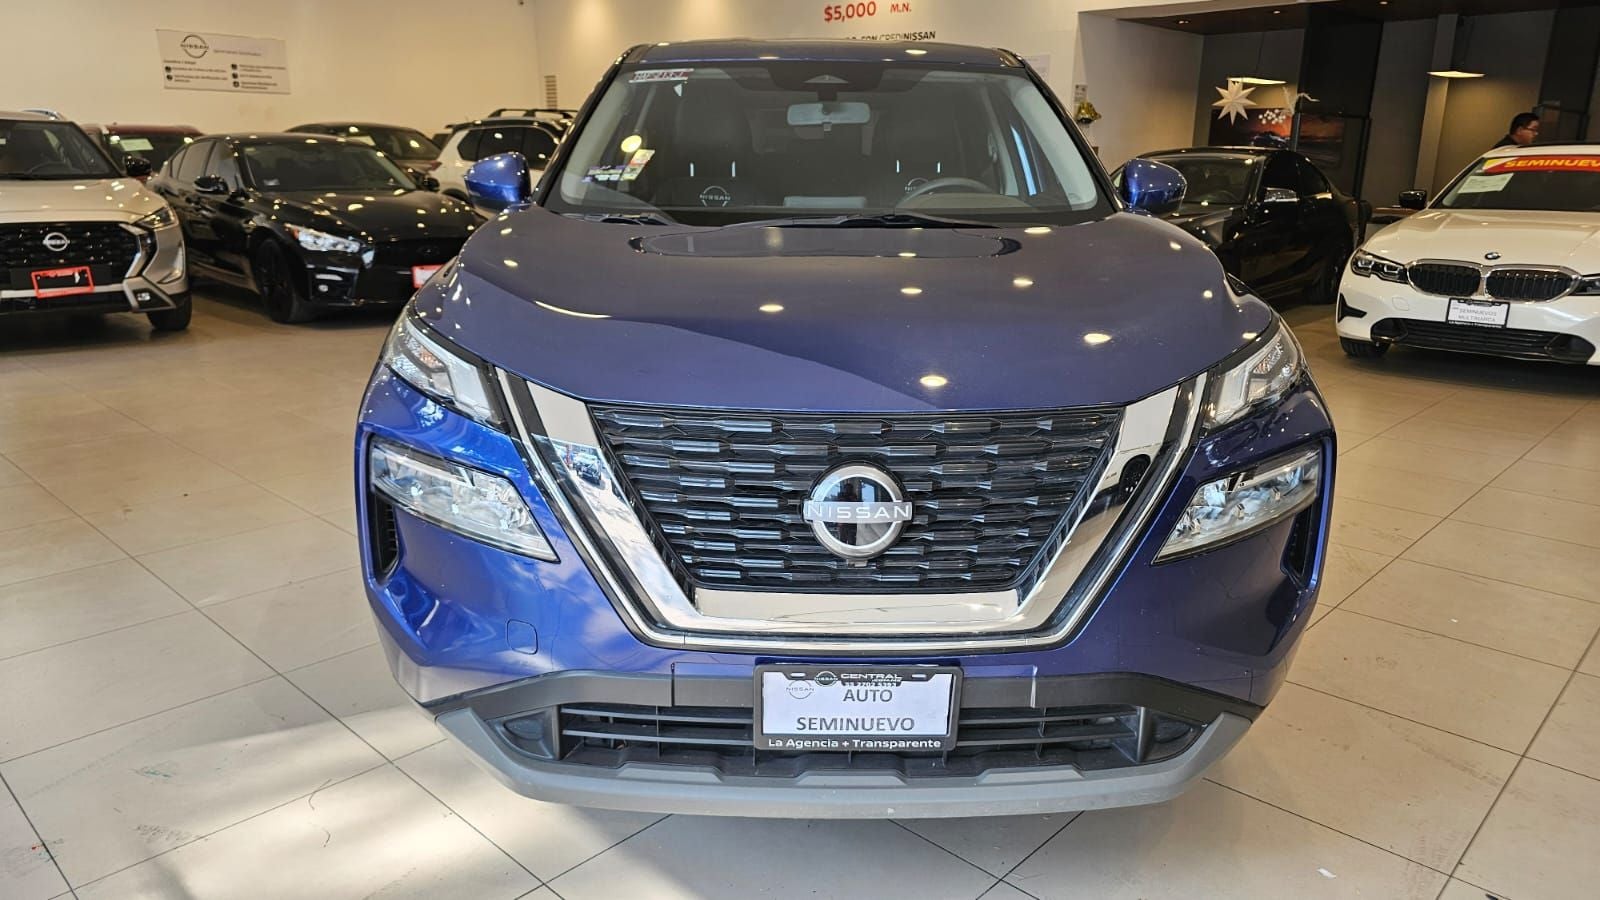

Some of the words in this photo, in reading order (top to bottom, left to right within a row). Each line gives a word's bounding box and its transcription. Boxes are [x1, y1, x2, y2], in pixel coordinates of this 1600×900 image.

[824, 1, 876, 22] $5,000
[890, 2, 912, 13] M.N.
[807, 505, 910, 519] NISSAN
[843, 689, 893, 702] AUTO
[796, 717, 915, 731] SEMINUEVO
[768, 739, 783, 747] La
[786, 739, 839, 749] Agencia
[852, 739, 942, 749] Transparente
